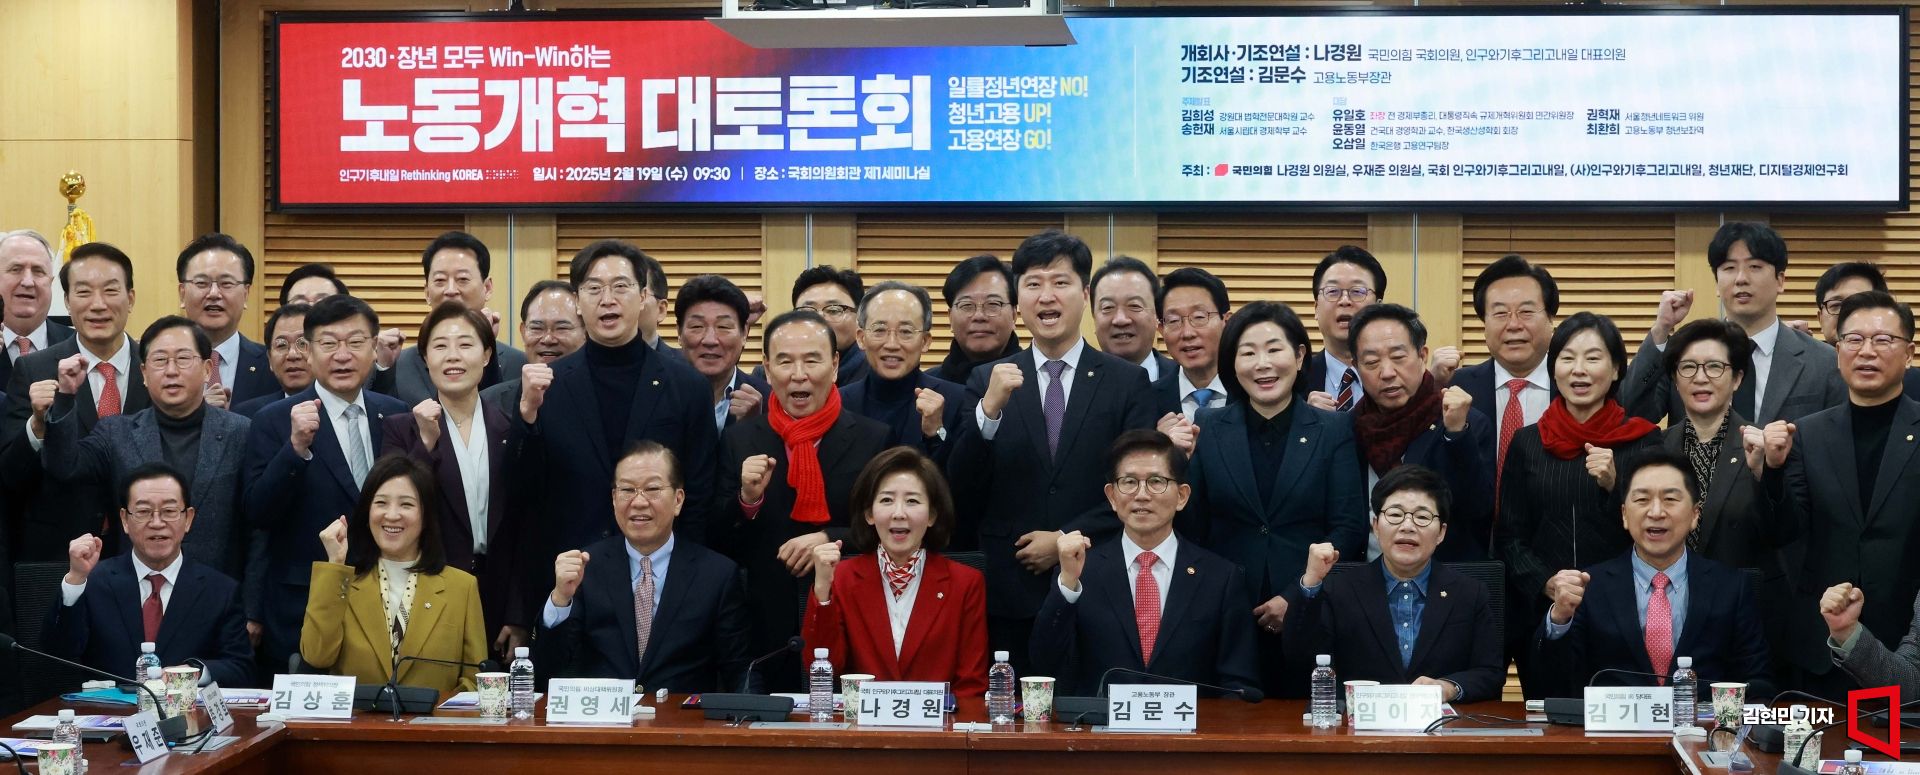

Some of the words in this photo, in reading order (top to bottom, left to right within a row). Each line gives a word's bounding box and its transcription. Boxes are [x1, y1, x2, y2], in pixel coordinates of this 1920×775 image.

[444, 45, 484, 69] 모두
[489, 45, 611, 69] Win-Win하는
[1314, 44, 1362, 62] 나경원
[1368, 48, 1413, 62] 국민의힘
[1416, 48, 1463, 62] 국회의원,
[1465, 48, 1578, 62] 인구와기후그리고내일
[1581, 48, 1626, 62] 대표의원
[1181, 66, 1245, 84] 기조연설
[1259, 66, 1307, 84] 김문수
[1313, 71, 1392, 84] 고용노동부장관
[948, 76, 1057, 98] 일률정년연장
[1060, 76, 1088, 98] NO!
[340, 75, 625, 152] 노동개혁
[642, 75, 931, 152] 대토론회
[948, 102, 1021, 124] 청년고용
[1024, 102, 1052, 124] UP!
[1182, 109, 1214, 122] 김희성
[1220, 112, 1242, 121] 강원대
[1244, 112, 1298, 121] 법학전문대학원
[1300, 112, 1315, 121] 교수
[1333, 109, 1366, 122] 유일호
[1388, 111, 1395, 120] 전
[1586, 108, 1620, 121] 권혁재
[1689, 111, 1704, 121] 위원
[1182, 123, 1214, 135] 송헌재
[1220, 126, 1258, 135] 서울시립대
[1260, 126, 1290, 135] 경제학부
[1292, 126, 1308, 135] 교수
[1333, 123, 1366, 136] 윤동열
[1370, 126, 1394, 136] 건국대
[1395, 126, 1426, 136] 경영학과
[1502, 126, 1519, 136] 회장
[1586, 123, 1620, 135] 최환희
[1625, 125, 1663, 135] 고용노동부
[948, 129, 1021, 151] 고용연장
[1024, 129, 1052, 151] GO!
[1333, 137, 1366, 150] 오삼일
[1370, 141, 1401, 150] 한국은행
[1403, 141, 1449, 150] 고용연구팀장
[339, 169, 400, 183] 인구기후내일
[401, 169, 451, 183] Rethinking
[452, 169, 483, 183] KOREA
[533, 167, 557, 181] 일시
[565, 167, 611, 181] 2025년
[613, 167, 634, 181] 2월
[637, 167, 663, 181] 19일
[665, 167, 688, 181] (수)
[693, 167, 731, 181] 09:30
[754, 166, 779, 181] 장소
[787, 166, 861, 180] 국회의원회관
[864, 166, 931, 180] 제1세미나실
[1182, 164, 1203, 177] 주최
[1232, 165, 1273, 176] 국민의힘
[1277, 164, 1310, 177] 나경원
[1313, 164, 1349, 177] 의원실,
[1352, 164, 1385, 177] 우재준
[1388, 164, 1425, 177] 의원실,
[1427, 164, 1450, 177] 국회
[1452, 164, 1568, 177] 인구와기후그리고내일,
[1708, 164, 1756, 177] 청년재단,
[1759, 164, 1848, 177] 디지털경제연구회
[550, 695, 630, 716] 권영세
[860, 698, 941, 718] 나경원
[1113, 701, 1195, 721] 김문수
[1588, 703, 1670, 723] 김기현
